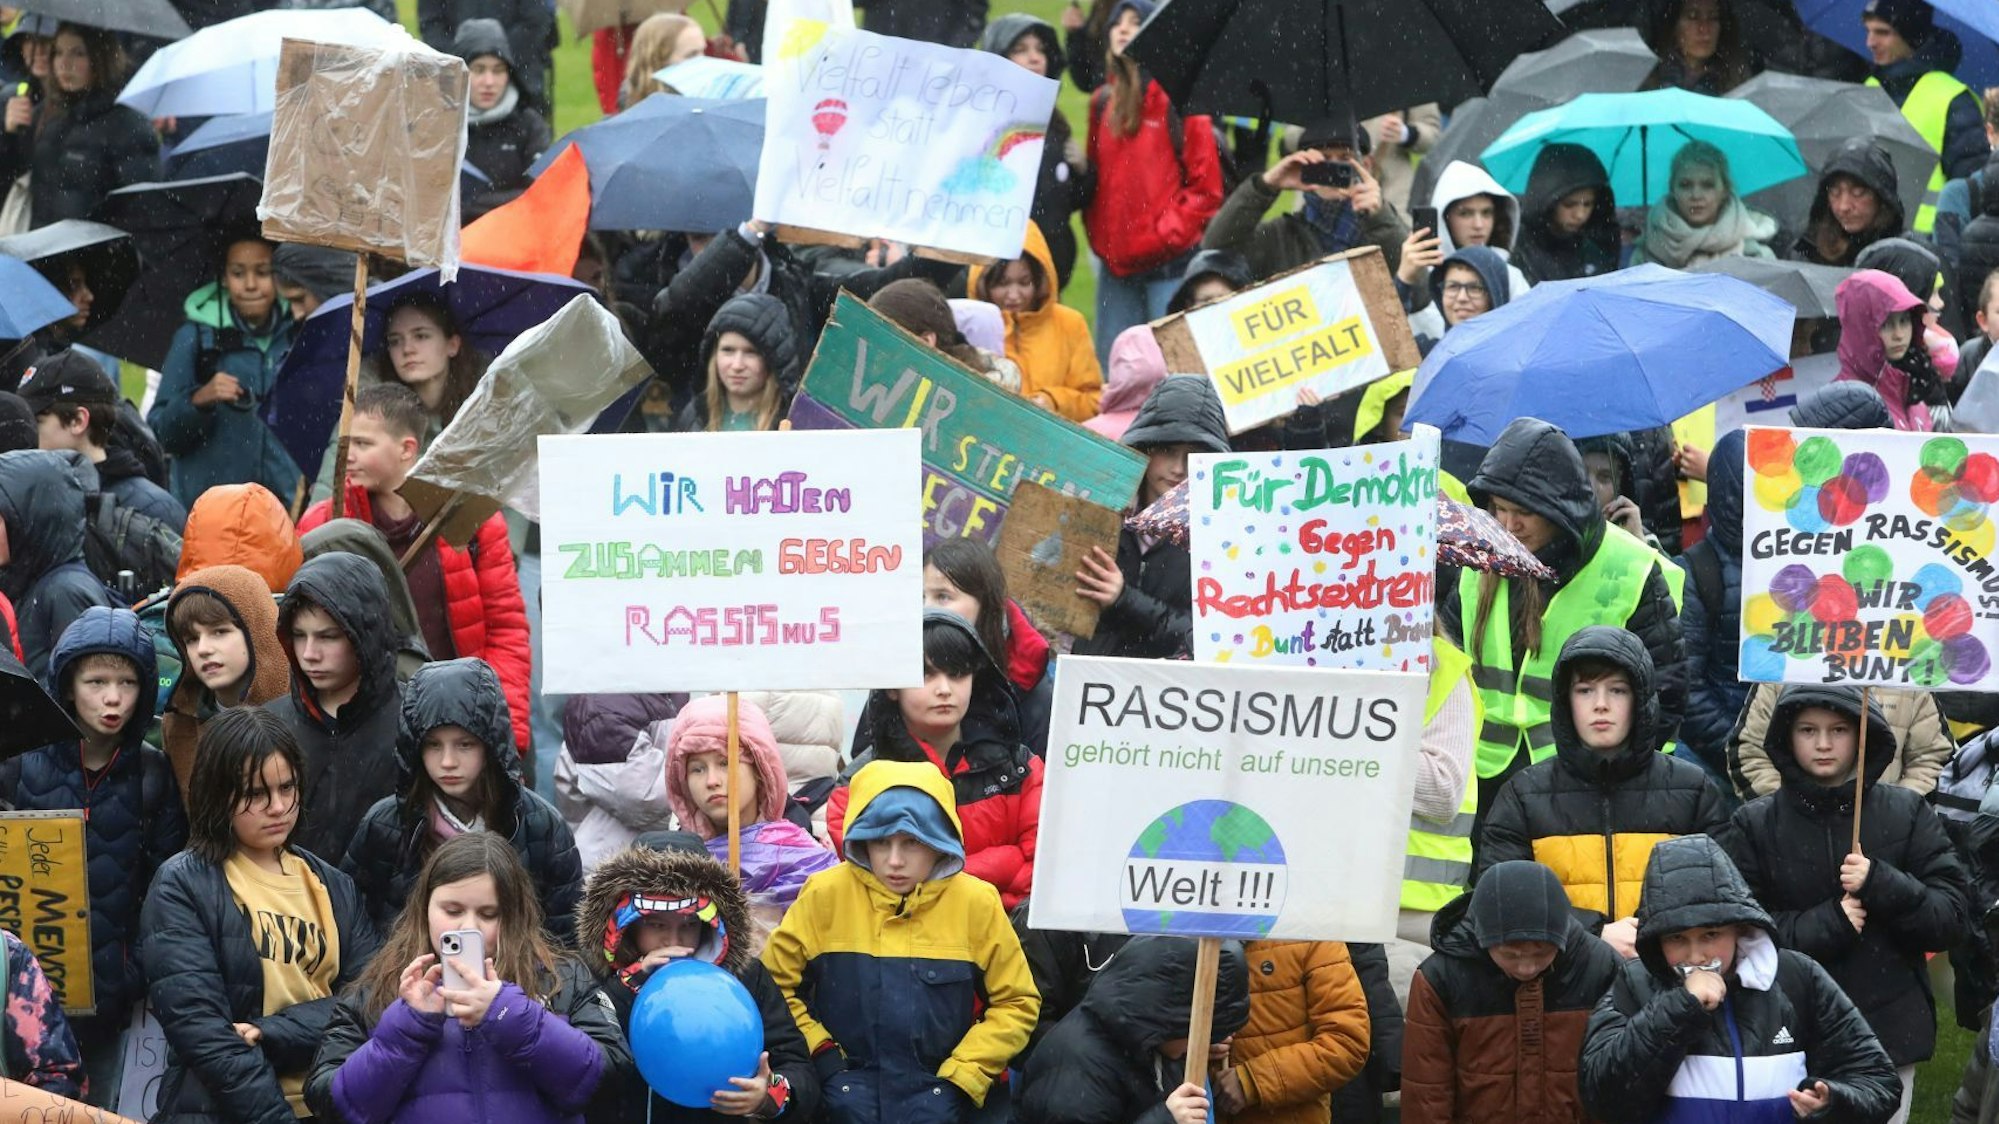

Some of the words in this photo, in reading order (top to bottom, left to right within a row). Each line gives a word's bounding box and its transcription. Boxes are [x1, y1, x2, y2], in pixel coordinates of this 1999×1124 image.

[799, 40, 911, 101] Vielfalt
[918, 63, 1018, 115] leben
[796, 146, 903, 215] Vielfalt
[904, 186, 1026, 231] nehmen
[1244, 298, 1309, 340] FÜR
[1225, 323, 1362, 395] VIELFALT
[850, 337, 957, 452] WIR
[725, 470, 852, 515] HALTEN
[1212, 459, 1295, 513] Für
[558, 541, 763, 580] ZUSAMMEN
[778, 538, 903, 575] GEGEN
[1298, 518, 1396, 570] Gegen
[1750, 527, 1853, 560] GEGEN
[1854, 578, 1923, 611] WIR
[1248, 620, 1316, 658] Bunt
[1320, 616, 1377, 653] statt
[1768, 618, 1915, 654] BLEIBEN
[1078, 681, 1399, 742] RASSISMUS
[1064, 740, 1151, 768] gehört
[1158, 745, 1223, 772] nicht
[1240, 750, 1286, 774] auf
[1291, 754, 1381, 779] unsere
[27, 827, 64, 876] Jeder
[1128, 865, 1223, 908] Welt
[1236, 871, 1275, 909] !!!
